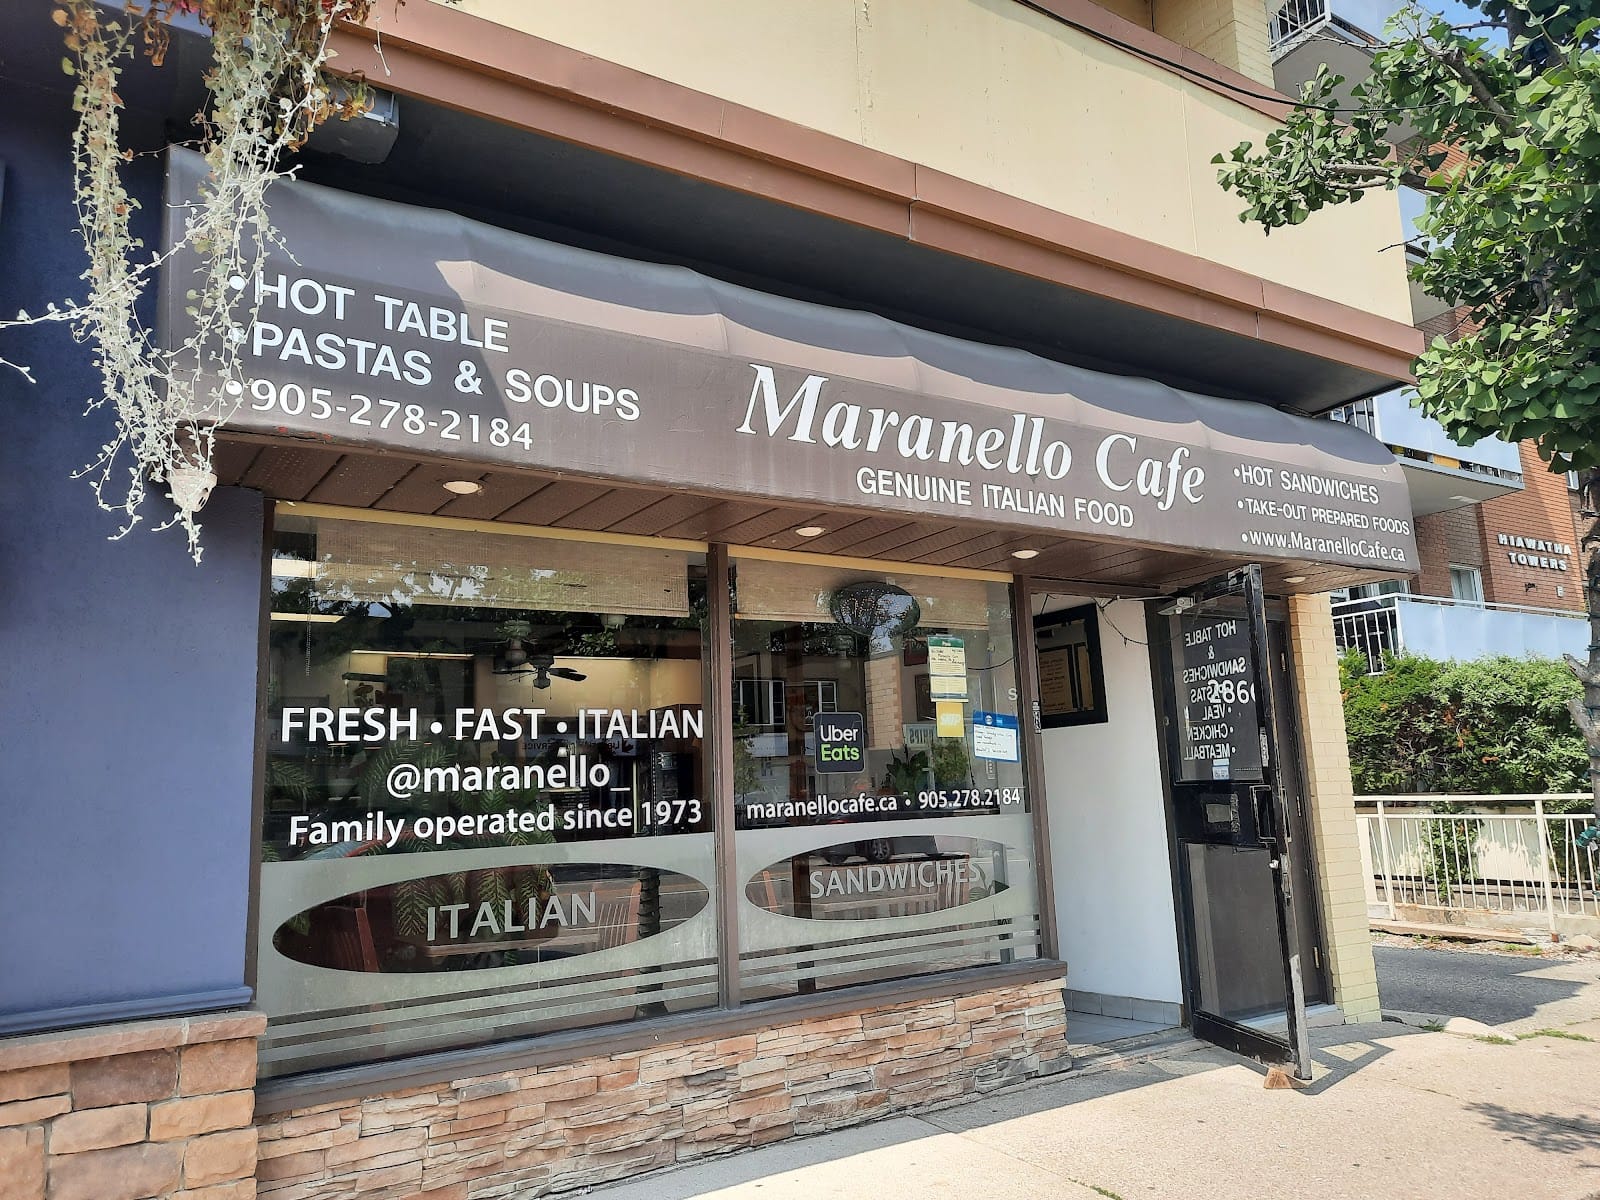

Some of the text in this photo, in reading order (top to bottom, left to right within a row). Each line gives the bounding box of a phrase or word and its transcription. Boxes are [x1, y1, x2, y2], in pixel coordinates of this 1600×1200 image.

[256, 270, 509, 353] HOT TABLE
[252, 320, 641, 421] PASTAS & SOUPS
[250, 379, 533, 450] 905-278-2184
[735, 363, 1206, 511] Maranello Cafe
[856, 466, 1134, 528] GENUINE ITALIAN FOOD
[1241, 465, 1379, 504] HOT SANDWICHES
[1245, 498, 1410, 535] TAKE-OUT PREPARED FOODS
[1249, 530, 1406, 562] www.MaranelloCafe.ca
[1498, 533, 1572, 555] HIAWATHA
[1508, 552, 1567, 571] TOWERS
[281, 706, 704, 742] FRESH FAST ITALIAN
[820, 724, 858, 742] Uber
[821, 744, 860, 762] Eats
[386, 754, 631, 798] @maranello_
[289, 799, 702, 848] Family operated since 1973
[747, 788, 1021, 820] maranellocafe.ca 905.278.2184
[809, 859, 982, 899] SANDWICHES
[426, 891, 597, 941] ITALIAN
